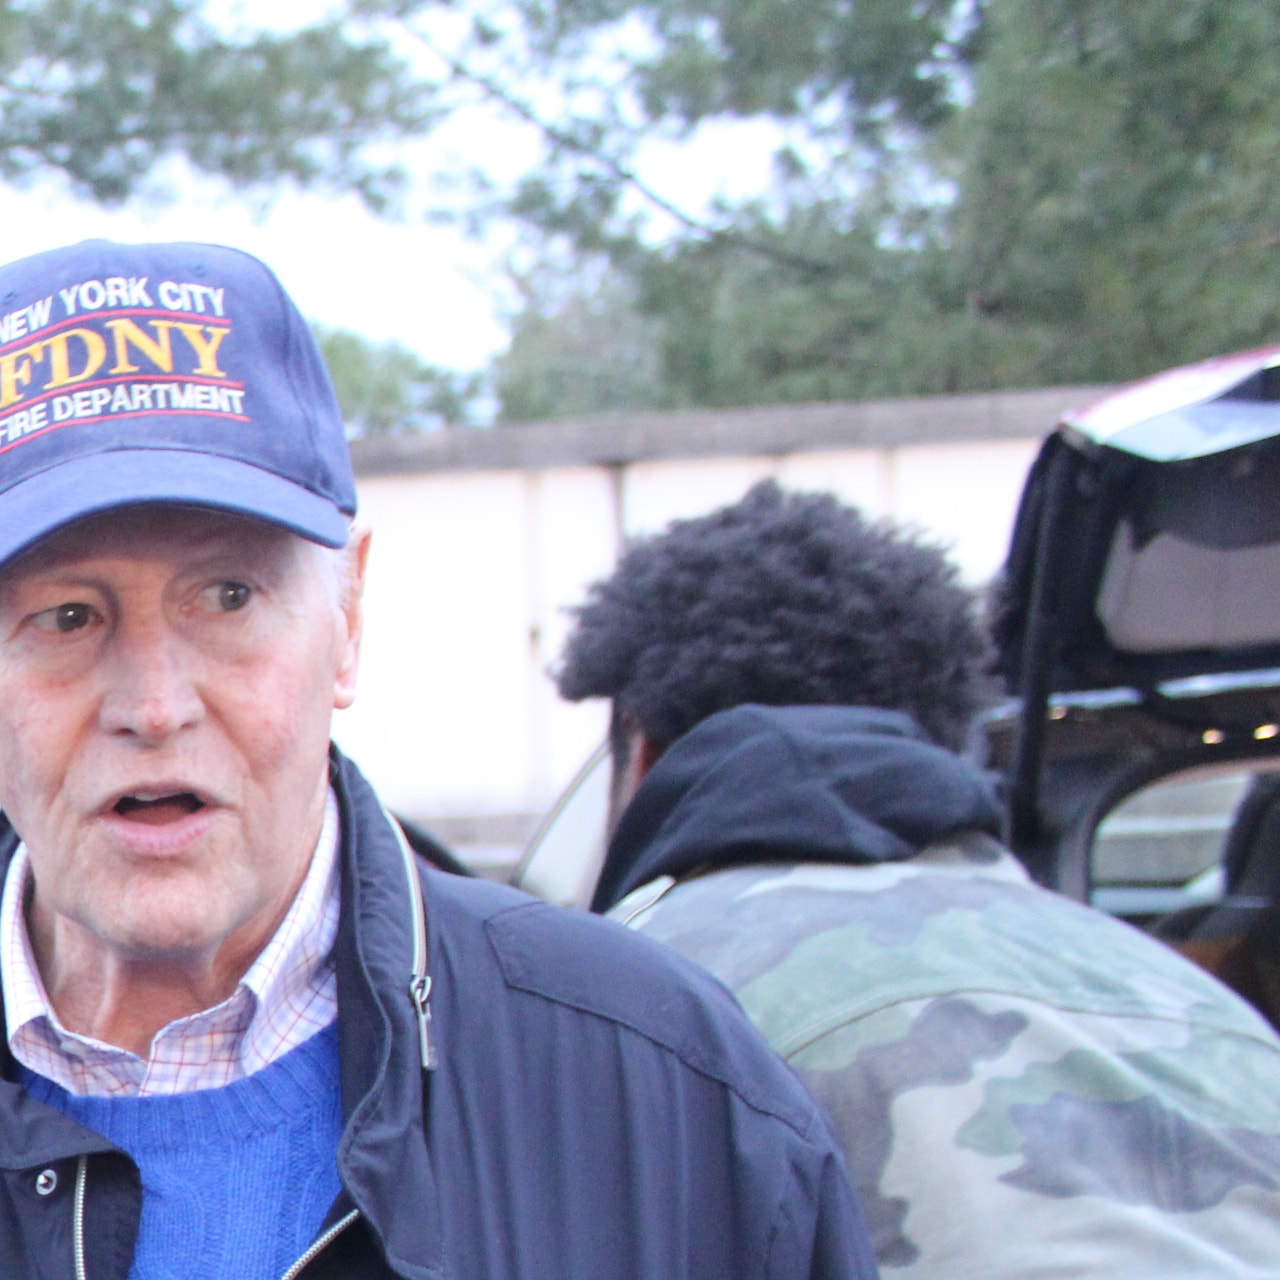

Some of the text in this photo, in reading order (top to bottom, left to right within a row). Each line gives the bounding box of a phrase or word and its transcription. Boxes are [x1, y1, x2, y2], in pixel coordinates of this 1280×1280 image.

[59, 276, 153, 316] YORK
[158, 281, 225, 317] CITY
[52, 383, 246, 422] DEPARTMENT
